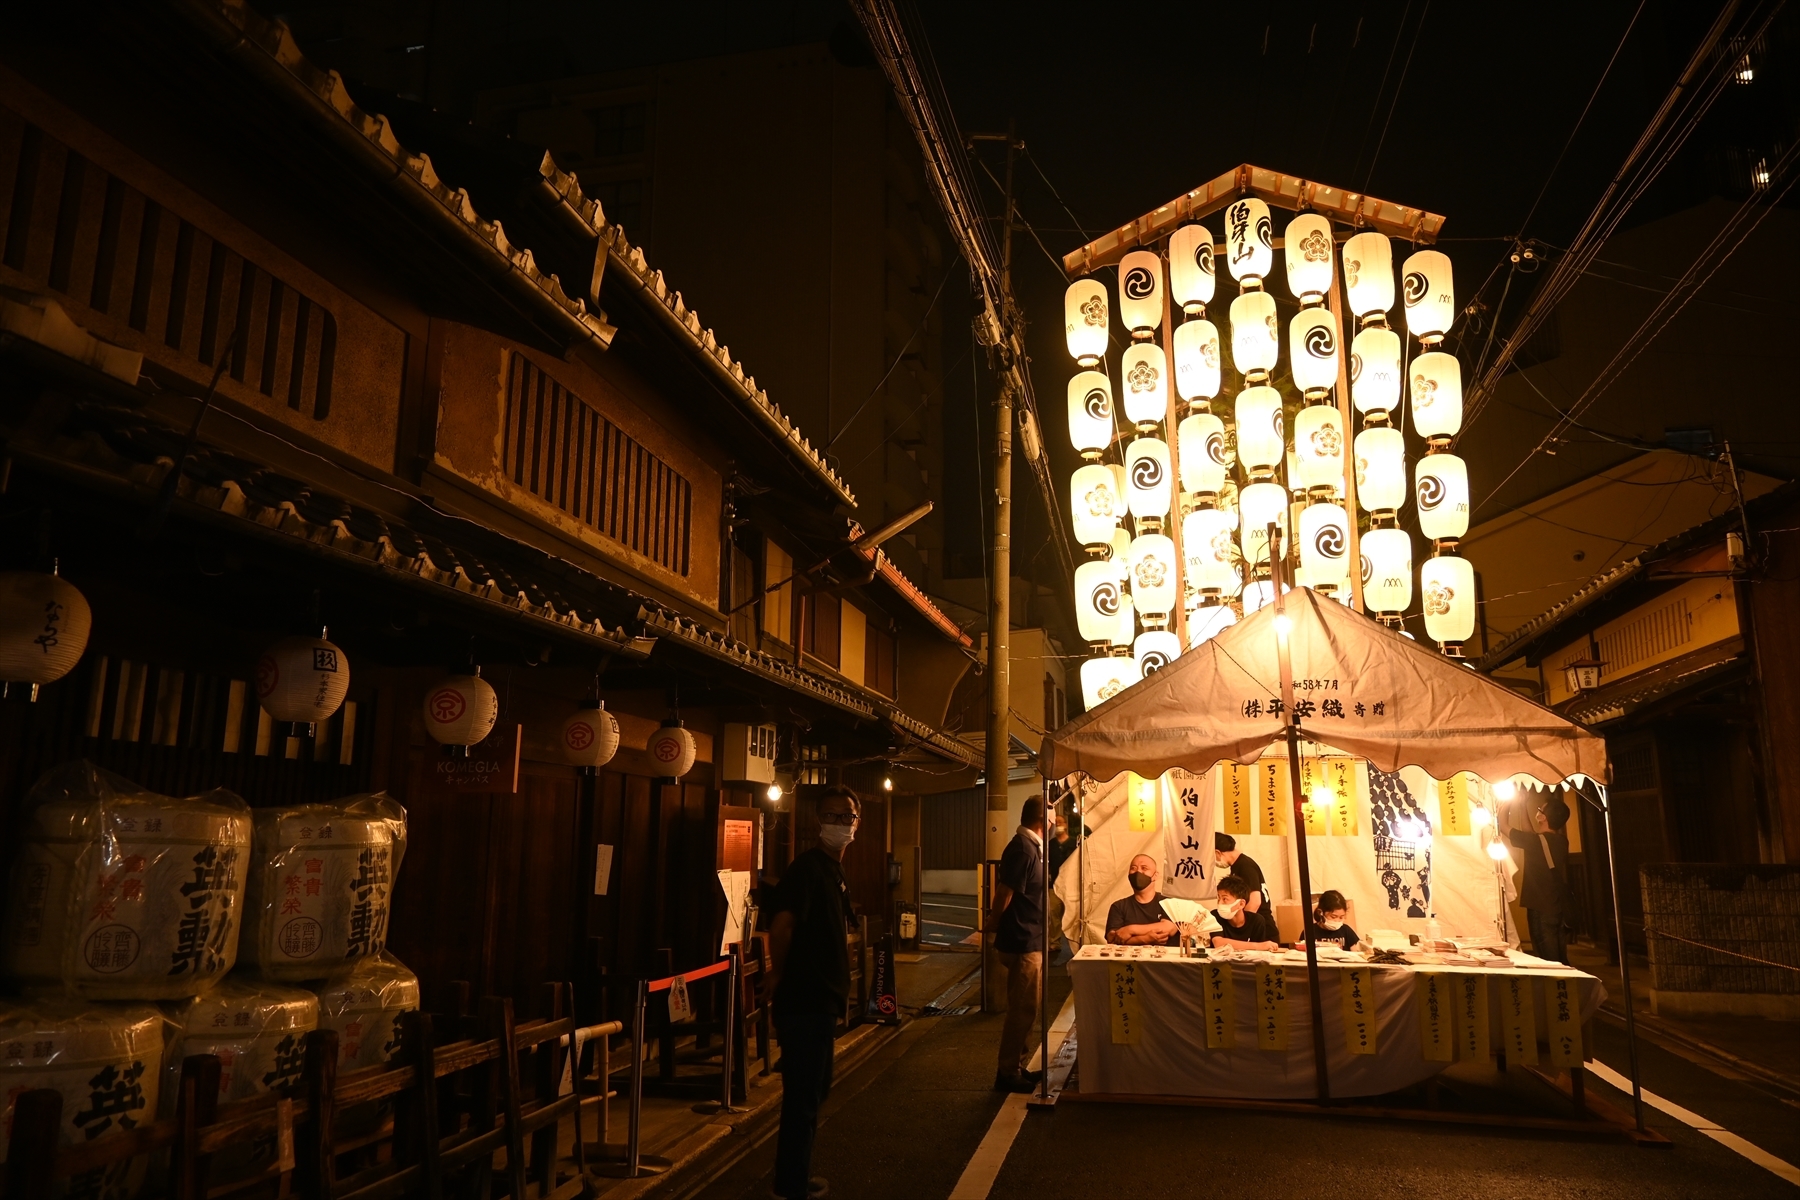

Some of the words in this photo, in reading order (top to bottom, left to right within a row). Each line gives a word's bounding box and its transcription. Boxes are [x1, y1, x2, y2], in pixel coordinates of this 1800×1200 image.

[1230, 202, 1255, 265] 伯牙山
[1279, 679, 1339, 690] 和58年7月
[437, 761, 500, 773] KOMEGLA
[1267, 764, 1276, 802] ちまき
[119, 817, 162, 833] 登録
[299, 826, 333, 839] 登録
[1180, 788, 1199, 851] 伯牙山
[119, 854, 147, 901] 富貴
[303, 858, 324, 897] 富貴
[878, 950, 886, 966] NO
[1211, 967, 1223, 1000] タオル
[1264, 973, 1276, 1010] 手ぬぐい
[1274, 968, 1285, 1001] 伯牙山
[1350, 971, 1364, 1014] ちまき
[1556, 979, 1570, 1022] 月刊京都
[212, 1011, 250, 1027] 登録
[6, 1041, 54, 1060] 登録
